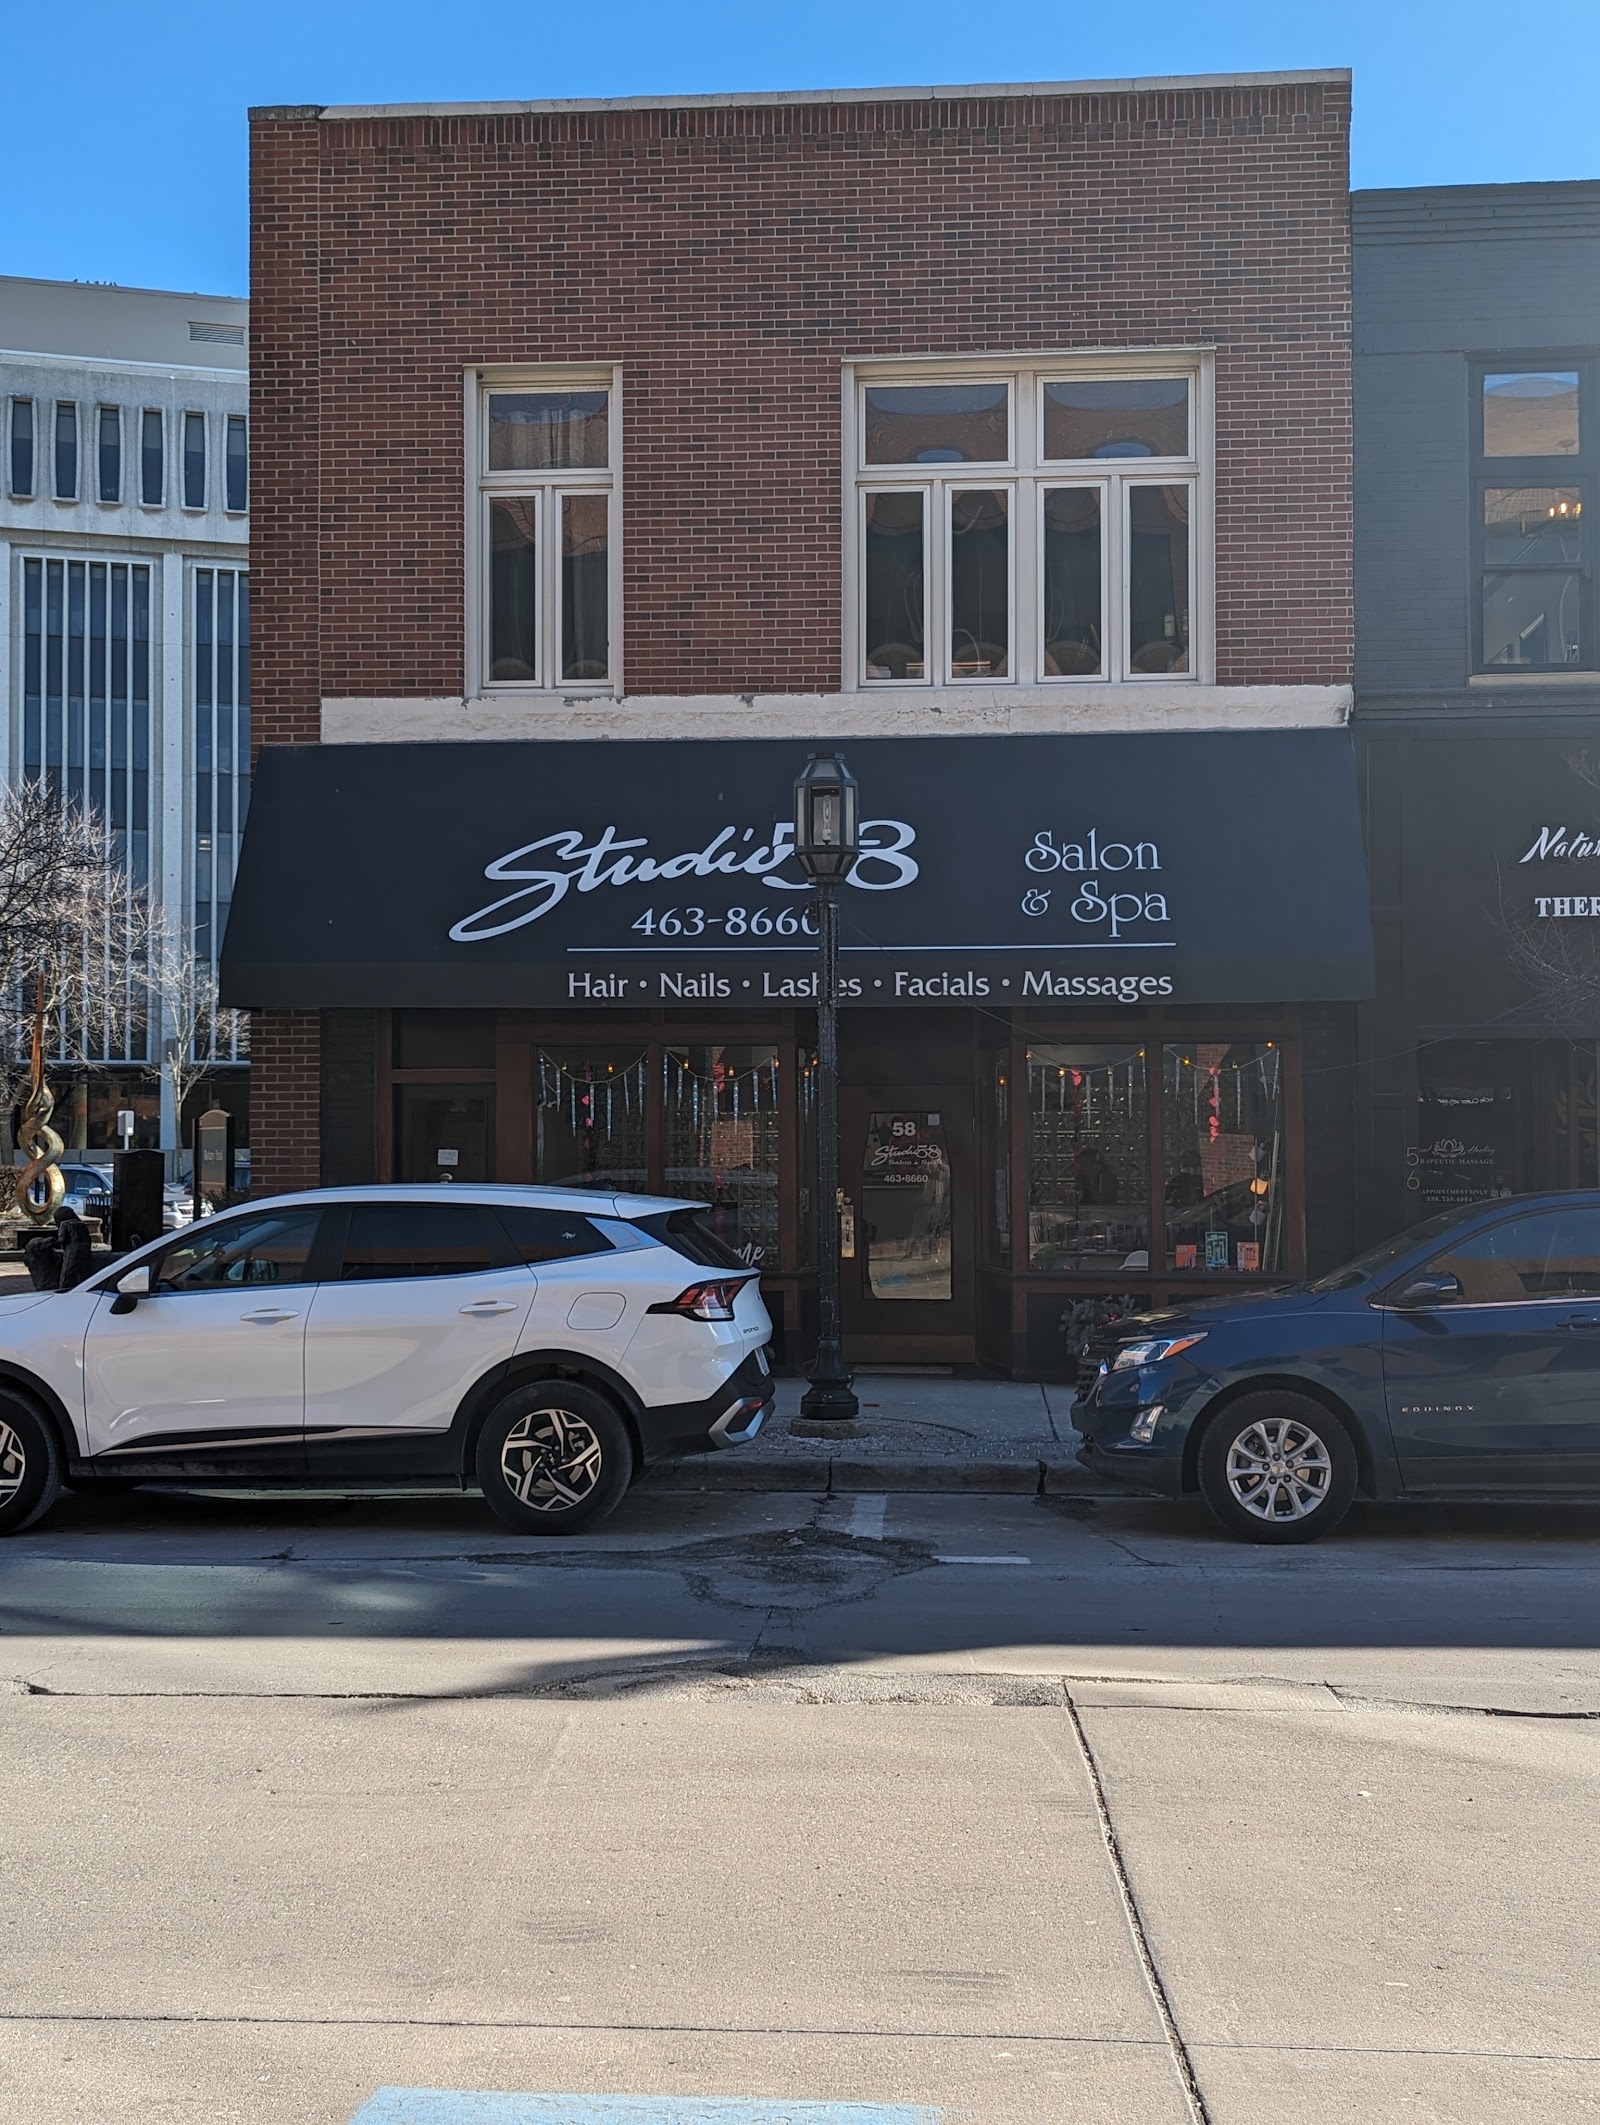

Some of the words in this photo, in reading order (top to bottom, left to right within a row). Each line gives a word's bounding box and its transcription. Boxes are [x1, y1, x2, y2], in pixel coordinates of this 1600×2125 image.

[1025, 827, 1162, 873] Salon
[1021, 888, 1052, 917] &
[1070, 879, 1171, 938] Spa
[568, 972, 629, 999] Hair
[659, 972, 731, 998] Nails
[763, 971, 862, 998] Lashes
[894, 971, 990, 998] Facials
[1022, 971, 1173, 1003] Massages
[892, 1122, 916, 1136] 58
[1401, 1404, 1474, 1413] EQUINOX
